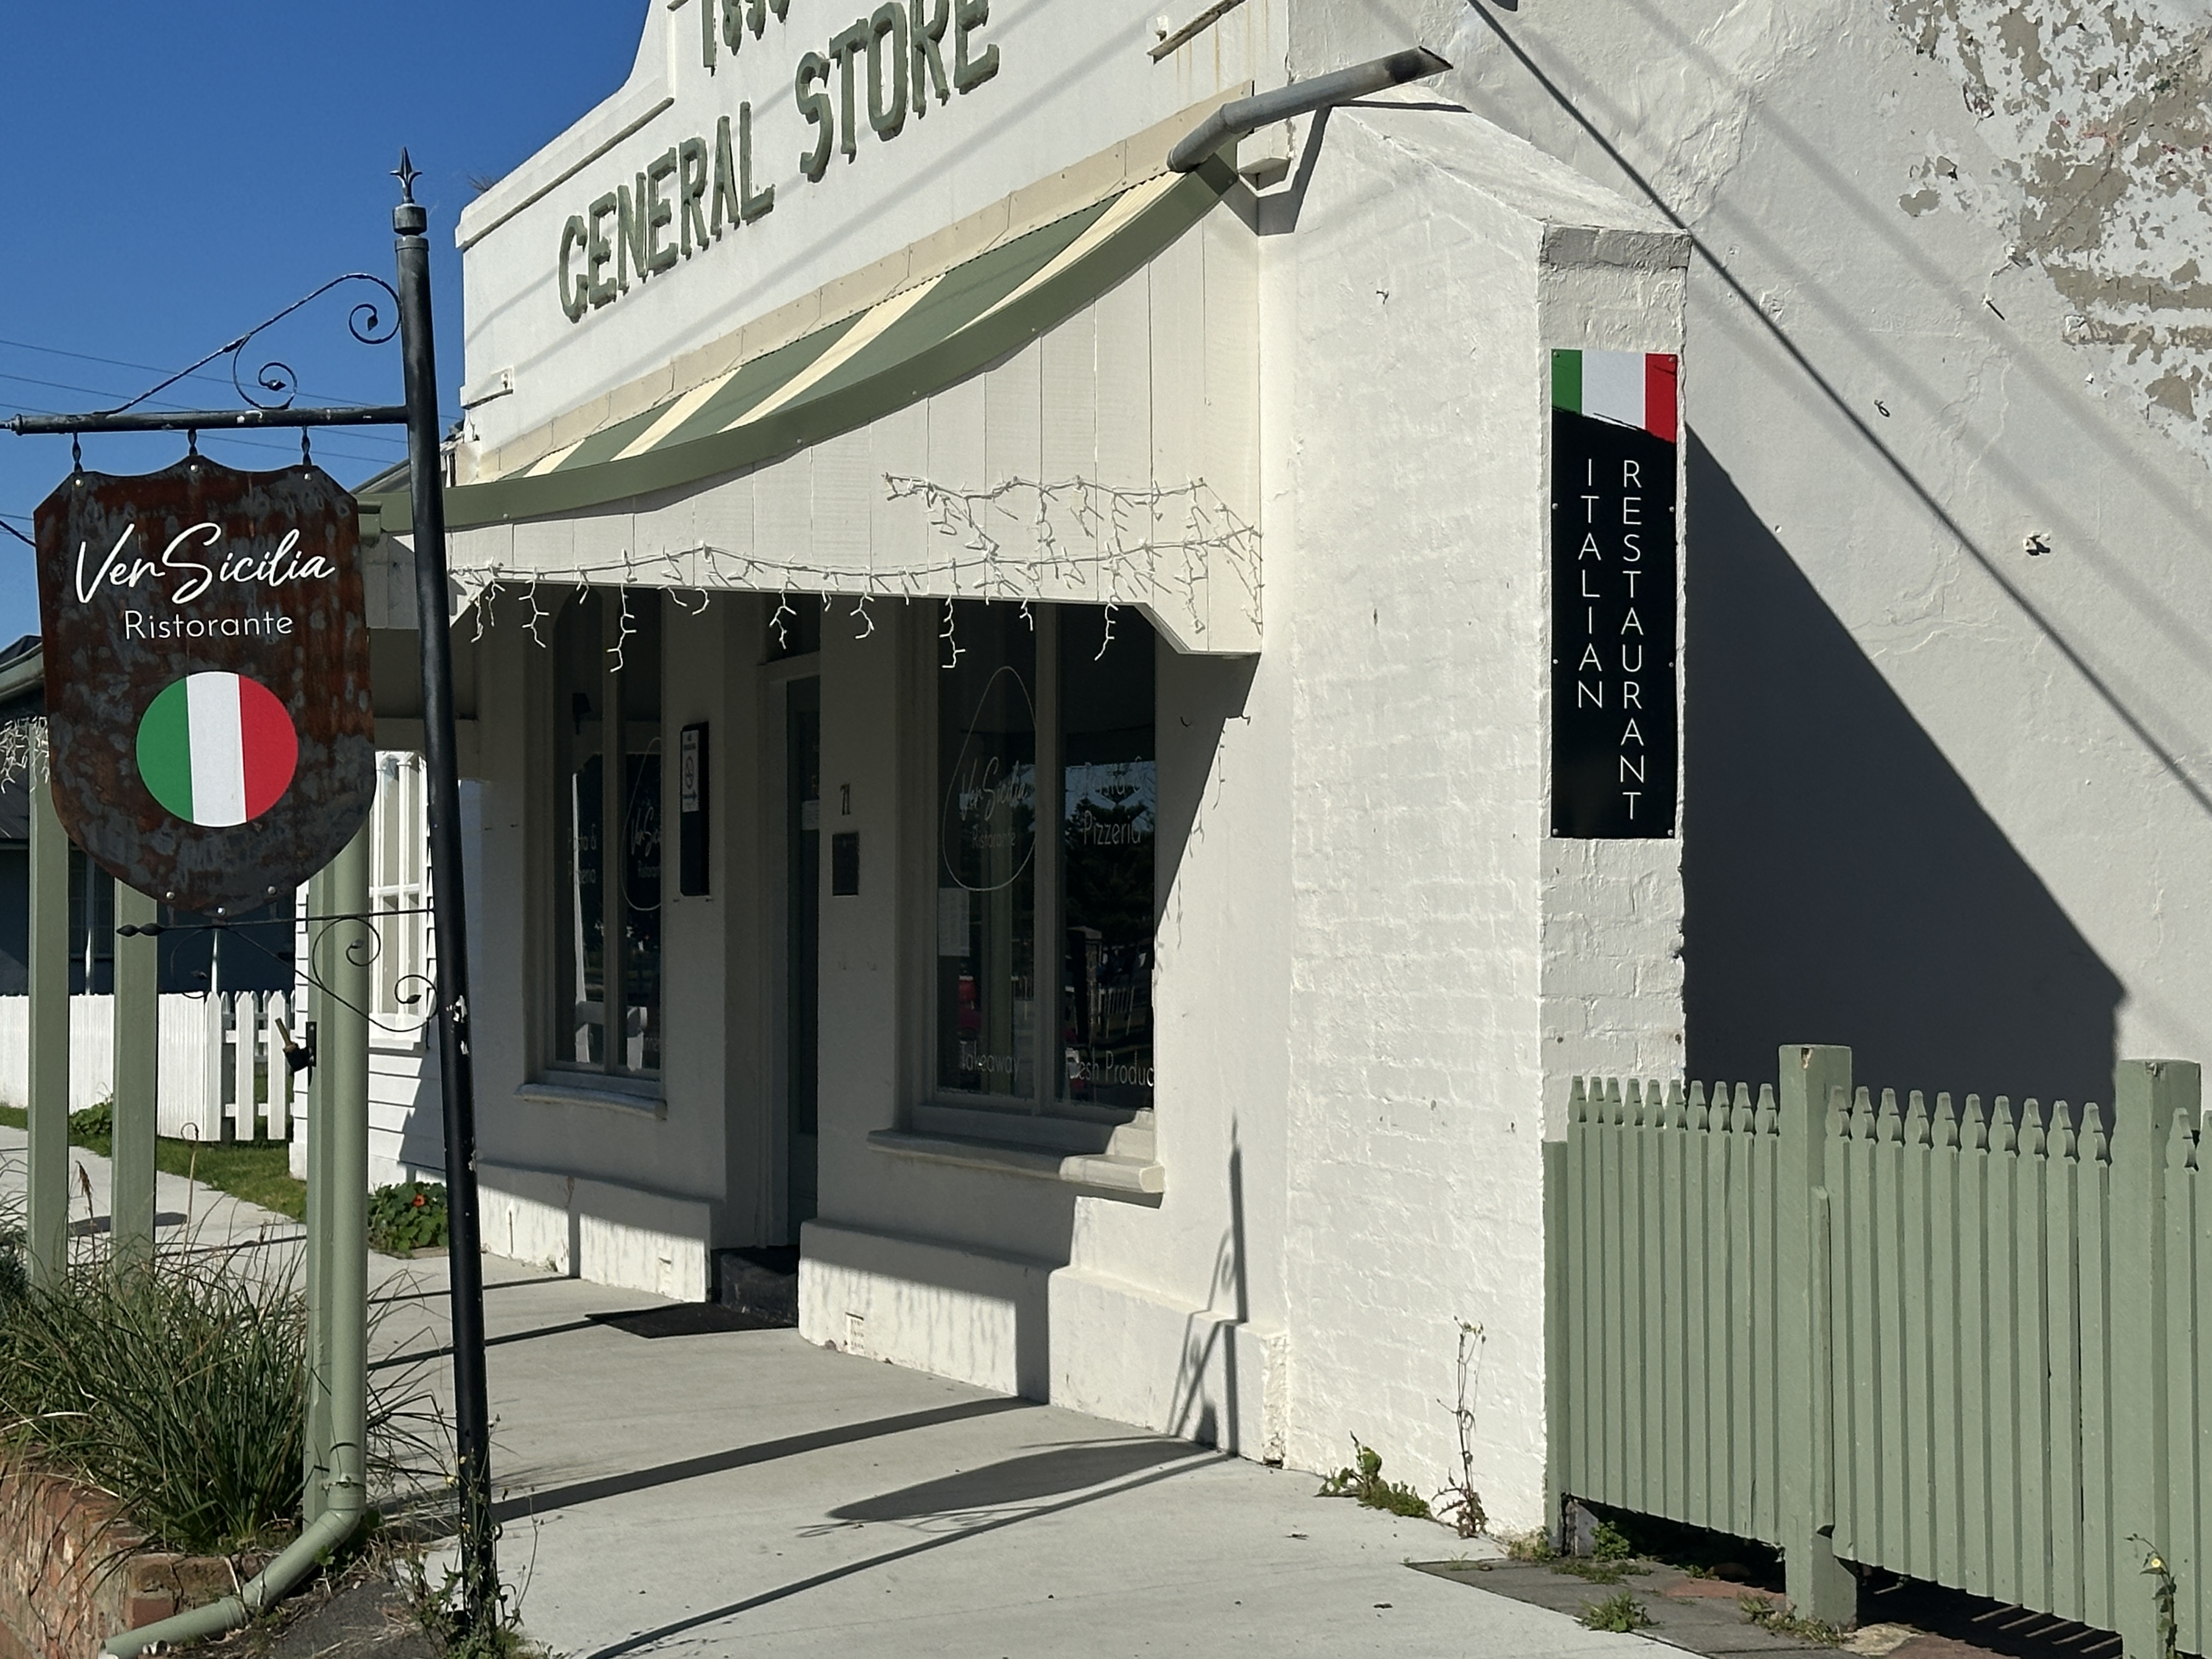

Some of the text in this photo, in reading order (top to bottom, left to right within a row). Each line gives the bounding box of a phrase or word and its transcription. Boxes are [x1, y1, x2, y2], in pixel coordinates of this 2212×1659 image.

[559, 0, 1000, 323] GENERAL STORE
[75, 522, 336, 604] VerSicilia
[124, 610, 294, 640] Ristorante
[1578, 459, 1602, 709] ITALIAN
[1620, 460, 1645, 820] RESTAURANT
[1084, 809, 1142, 846] Pizzeria
